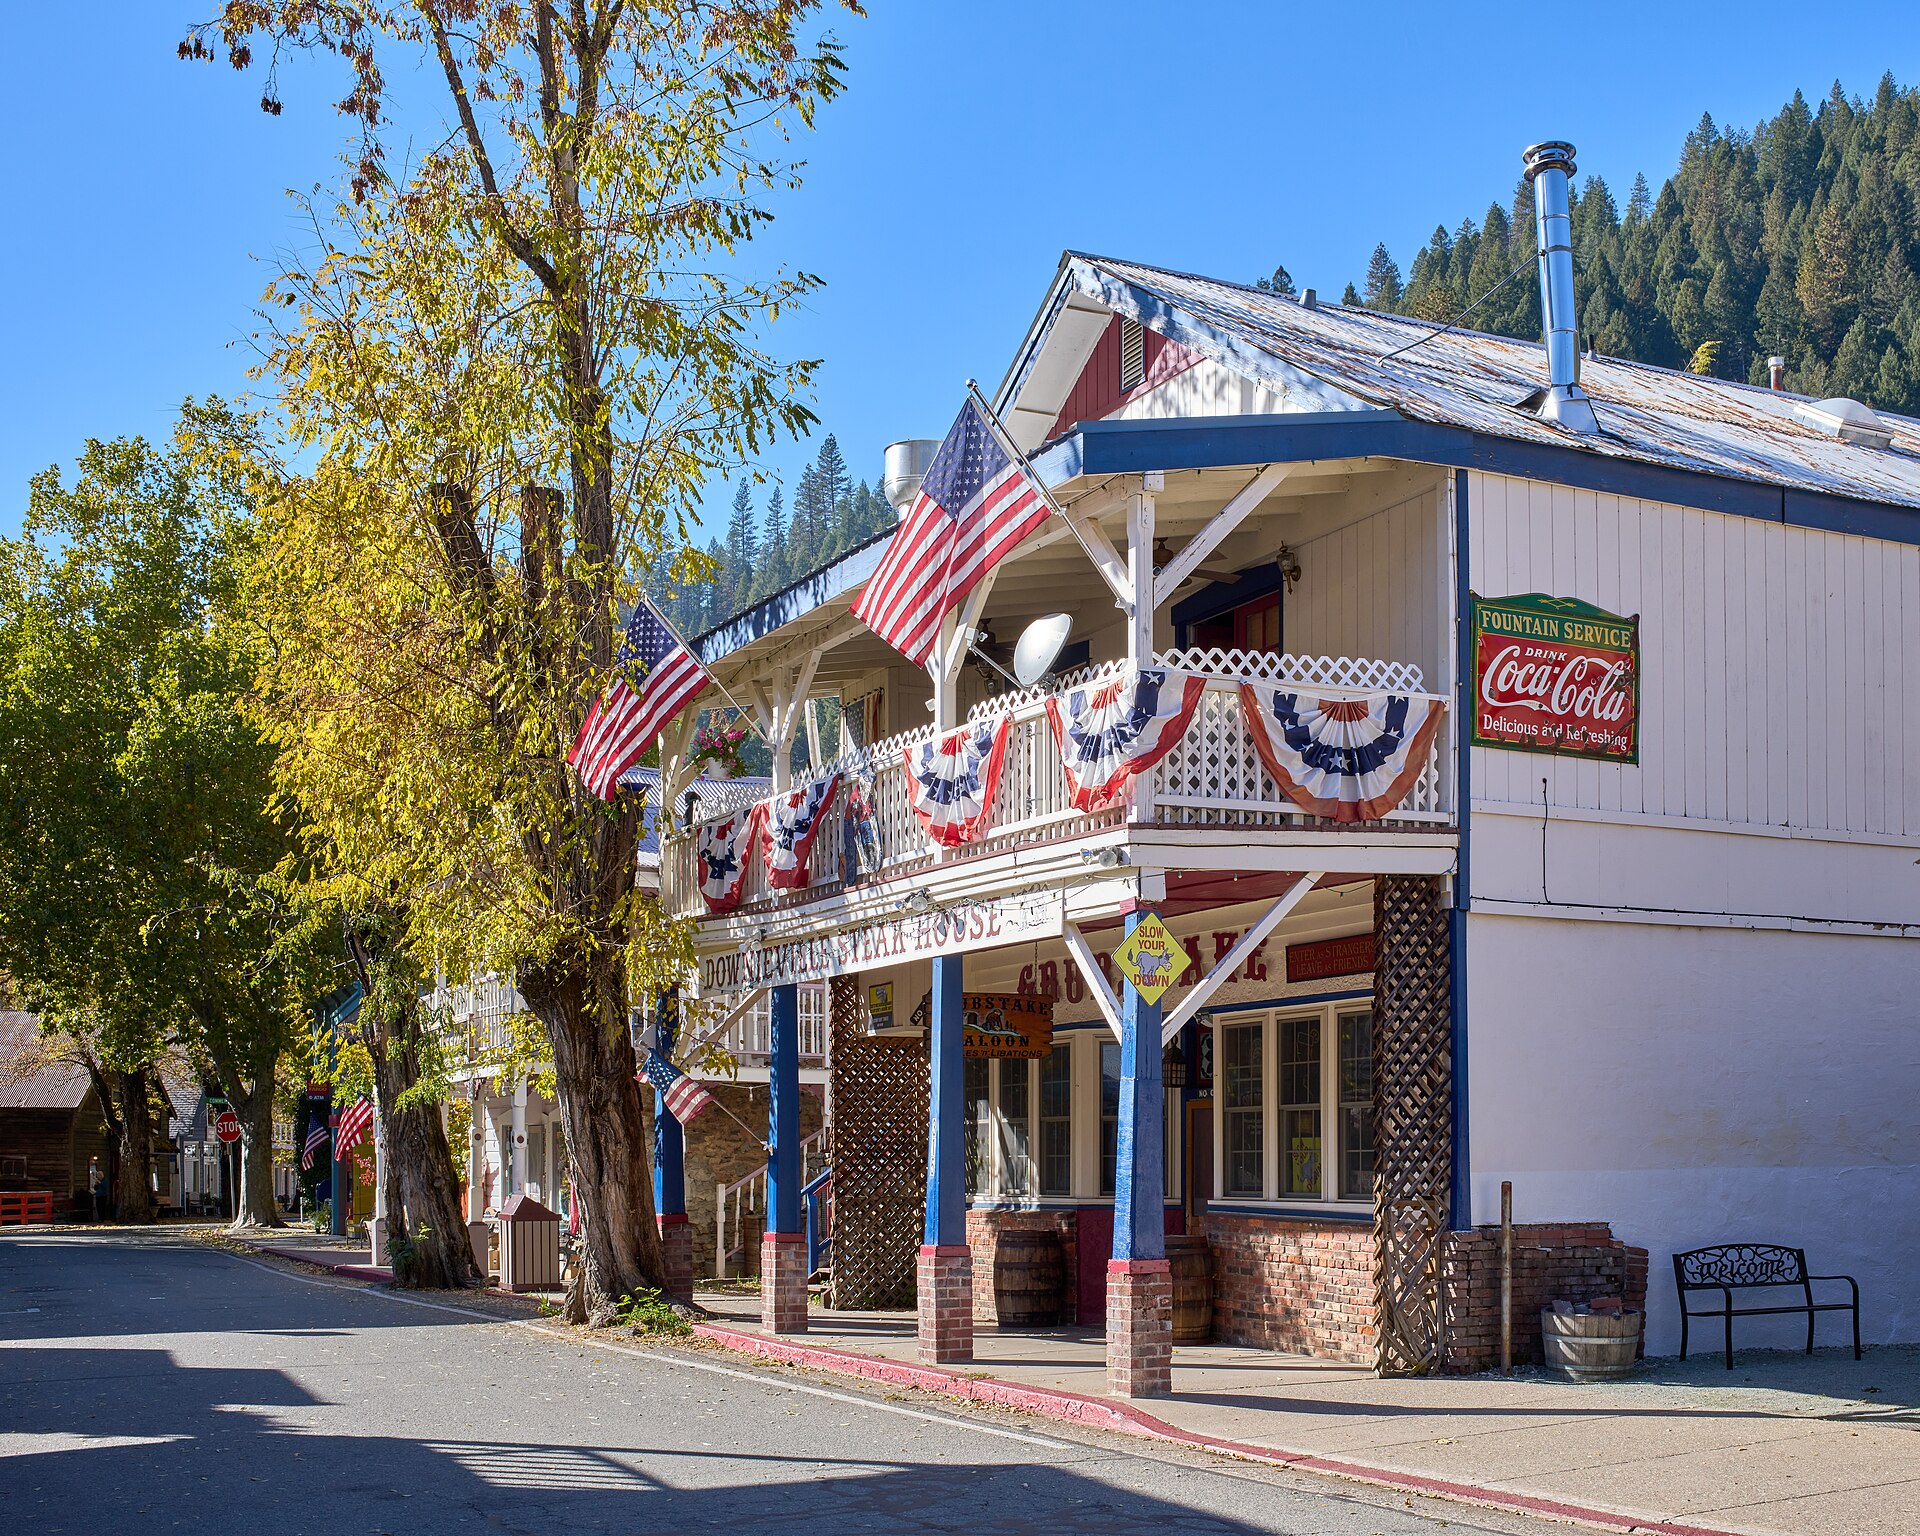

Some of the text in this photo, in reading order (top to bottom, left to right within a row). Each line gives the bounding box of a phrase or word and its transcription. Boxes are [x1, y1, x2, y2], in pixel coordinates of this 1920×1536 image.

[1481, 610, 1632, 648] FOUNTAIN SERVICE
[1525, 647, 1568, 661] DRINK
[1483, 714, 1538, 735] Delicious
[1139, 926, 1164, 938] SLOW
[704, 897, 1001, 990] DOWNIEVILLE STEAK HOUSE
[1138, 940, 1165, 950] YOUR
[1289, 949, 1315, 963] ENTER
[1296, 961, 1322, 976] LEAVE
[1333, 956, 1369, 971] FRIENDS
[1134, 974, 1169, 987] DOWN
[963, 997, 1048, 1015] BSTAKE
[912, 1009, 923, 1022] NO
[963, 1035, 1030, 1047] ALOON
[991, 1049, 1043, 1058] LIBATIONS
